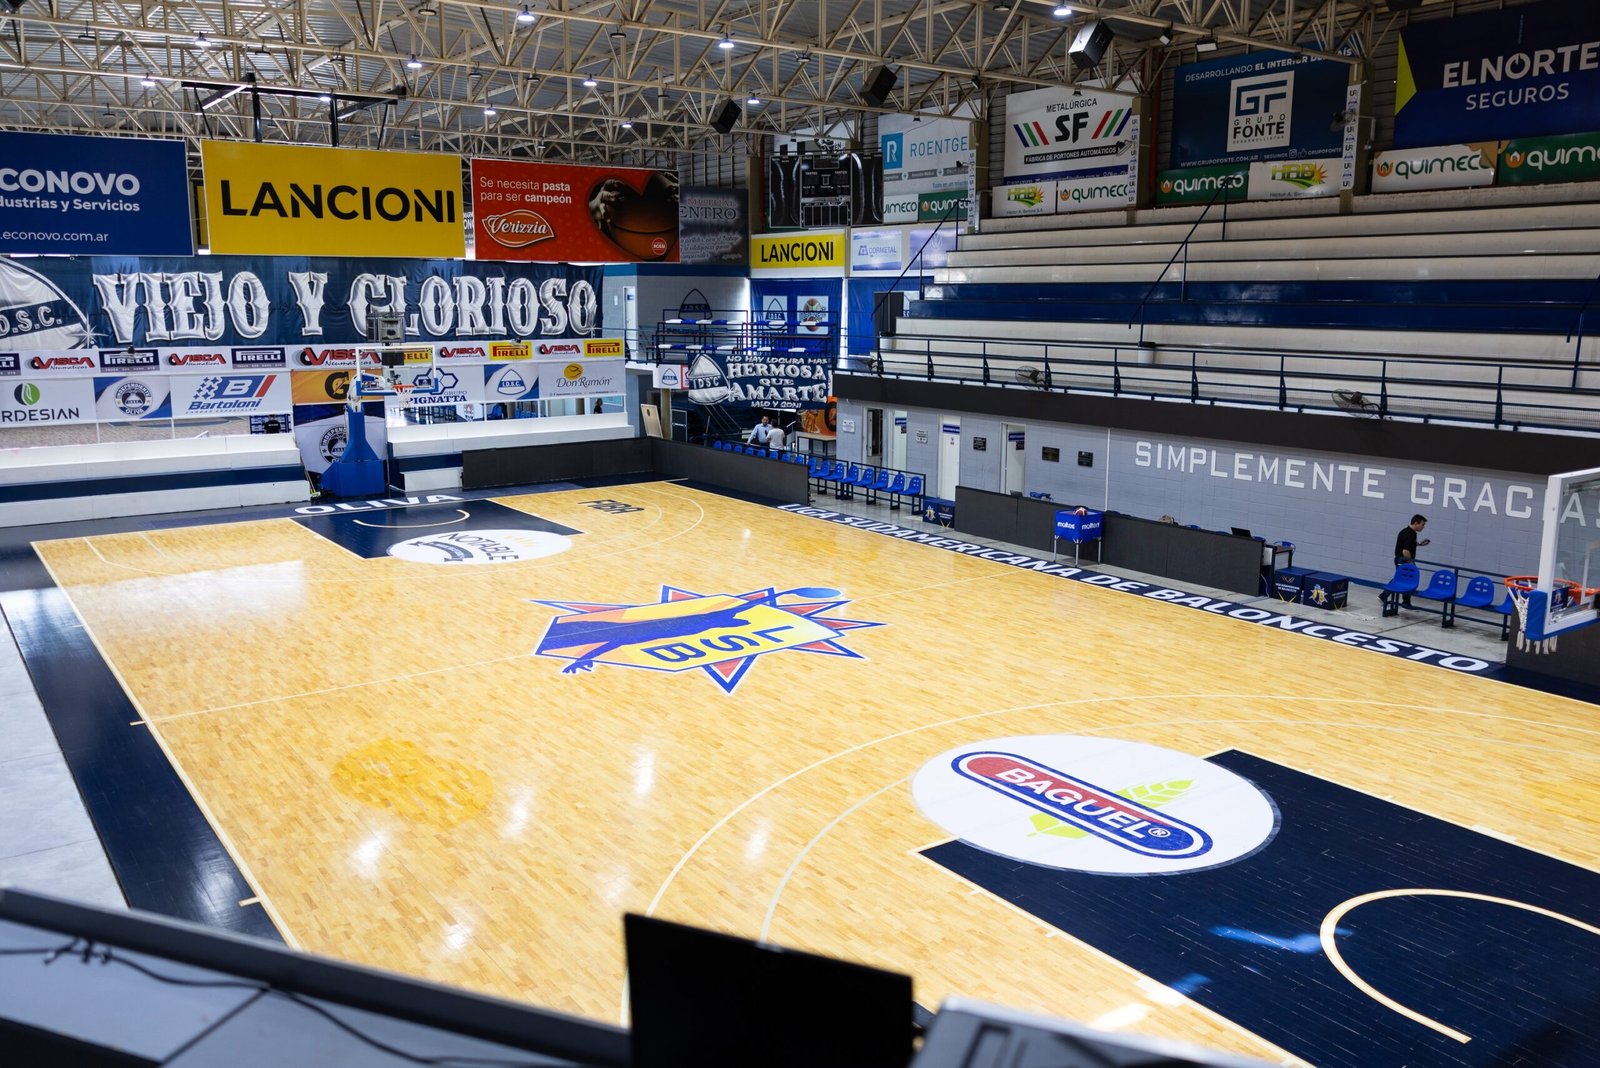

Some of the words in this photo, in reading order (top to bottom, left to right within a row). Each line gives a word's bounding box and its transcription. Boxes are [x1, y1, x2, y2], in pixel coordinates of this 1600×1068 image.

[1185, 65, 1253, 82] DESARROLLANDO
[1254, 63, 1265, 71] EL
[1465, 82, 1569, 111] SEGUROS
[1046, 98, 1098, 113] METALÚRGICA
[1055, 112, 1089, 144] SF
[1233, 113, 1286, 126] GRUPO
[1233, 122, 1284, 139] FONTE
[910, 135, 968, 158] ROENTGE
[1053, 151, 1080, 160] PORTONES
[0, 167, 140, 196] CONOVO
[480, 176, 494, 188] Se
[497, 179, 540, 191] necesita
[542, 182, 571, 193] pasta
[60, 200, 70, 212] y
[73, 197, 140, 213] Servicios
[220, 179, 456, 223] LANCIONI
[480, 191, 503, 203] para
[505, 193, 521, 202] ser
[524, 193, 572, 205] campeón
[487, 214, 548, 235] Verizzia
[761, 240, 834, 263] LANCIONI
[93, 270, 271, 344] VIEJO
[289, 271, 328, 337] Y
[346, 272, 598, 338] GLORIOSO
[235, 350, 282, 362] PIRELLI
[492, 345, 529, 357] PIRELLI
[586, 342, 620, 354] PIRELLI
[103, 352, 155, 365] PIRELLI
[726, 355, 742, 363] NO
[727, 362, 827, 380] HERMOSA
[556, 377, 577, 388] Don
[577, 376, 611, 388] Ramón
[758, 377, 795, 387] QUE
[728, 381, 828, 403] AMARTE
[188, 398, 262, 411] Bartoloni
[2, 407, 80, 423] RDESIAN
[1135, 441, 1387, 500] SIMPLEMENTE
[1410, 473, 1600, 529] GRACA
[294, 493, 465, 514] OLIVA
[437, 532, 520, 561] NOTABLE
[777, 503, 833, 519] LIGA
[832, 516, 1083, 577] SUDAMERICANA
[1081, 574, 1150, 592] DE
[1143, 588, 1490, 672] BALONCESTO
